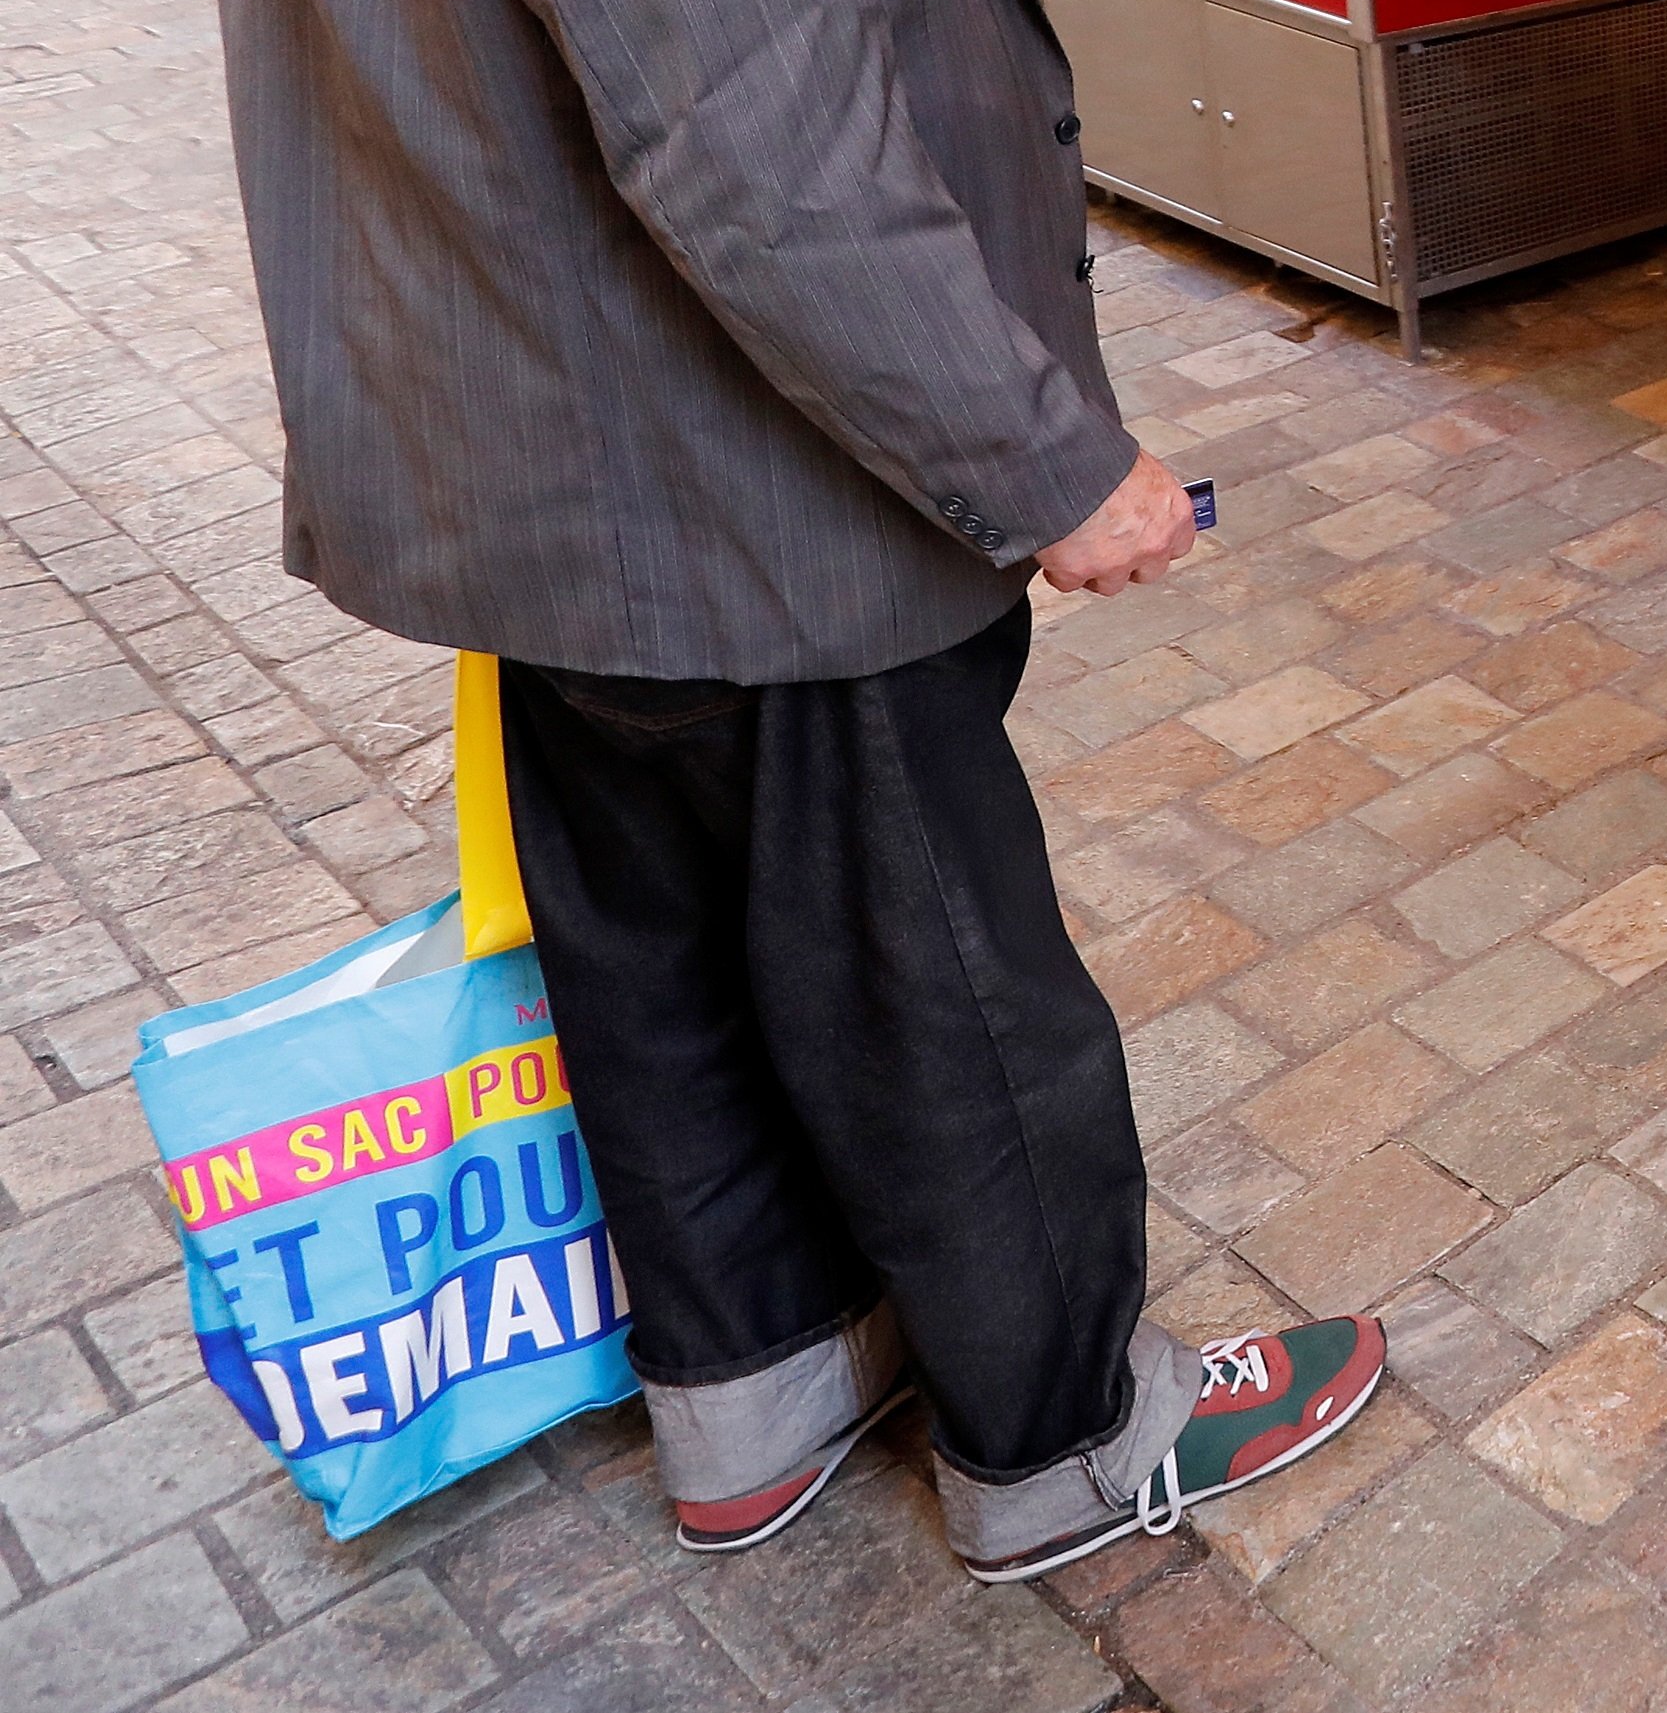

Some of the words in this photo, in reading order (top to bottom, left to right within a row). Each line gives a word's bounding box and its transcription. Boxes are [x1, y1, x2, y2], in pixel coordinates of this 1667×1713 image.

[167, 1150, 264, 1224] UN
[287, 1095, 428, 1186] SAC
[203, 1219, 322, 1343] ET
